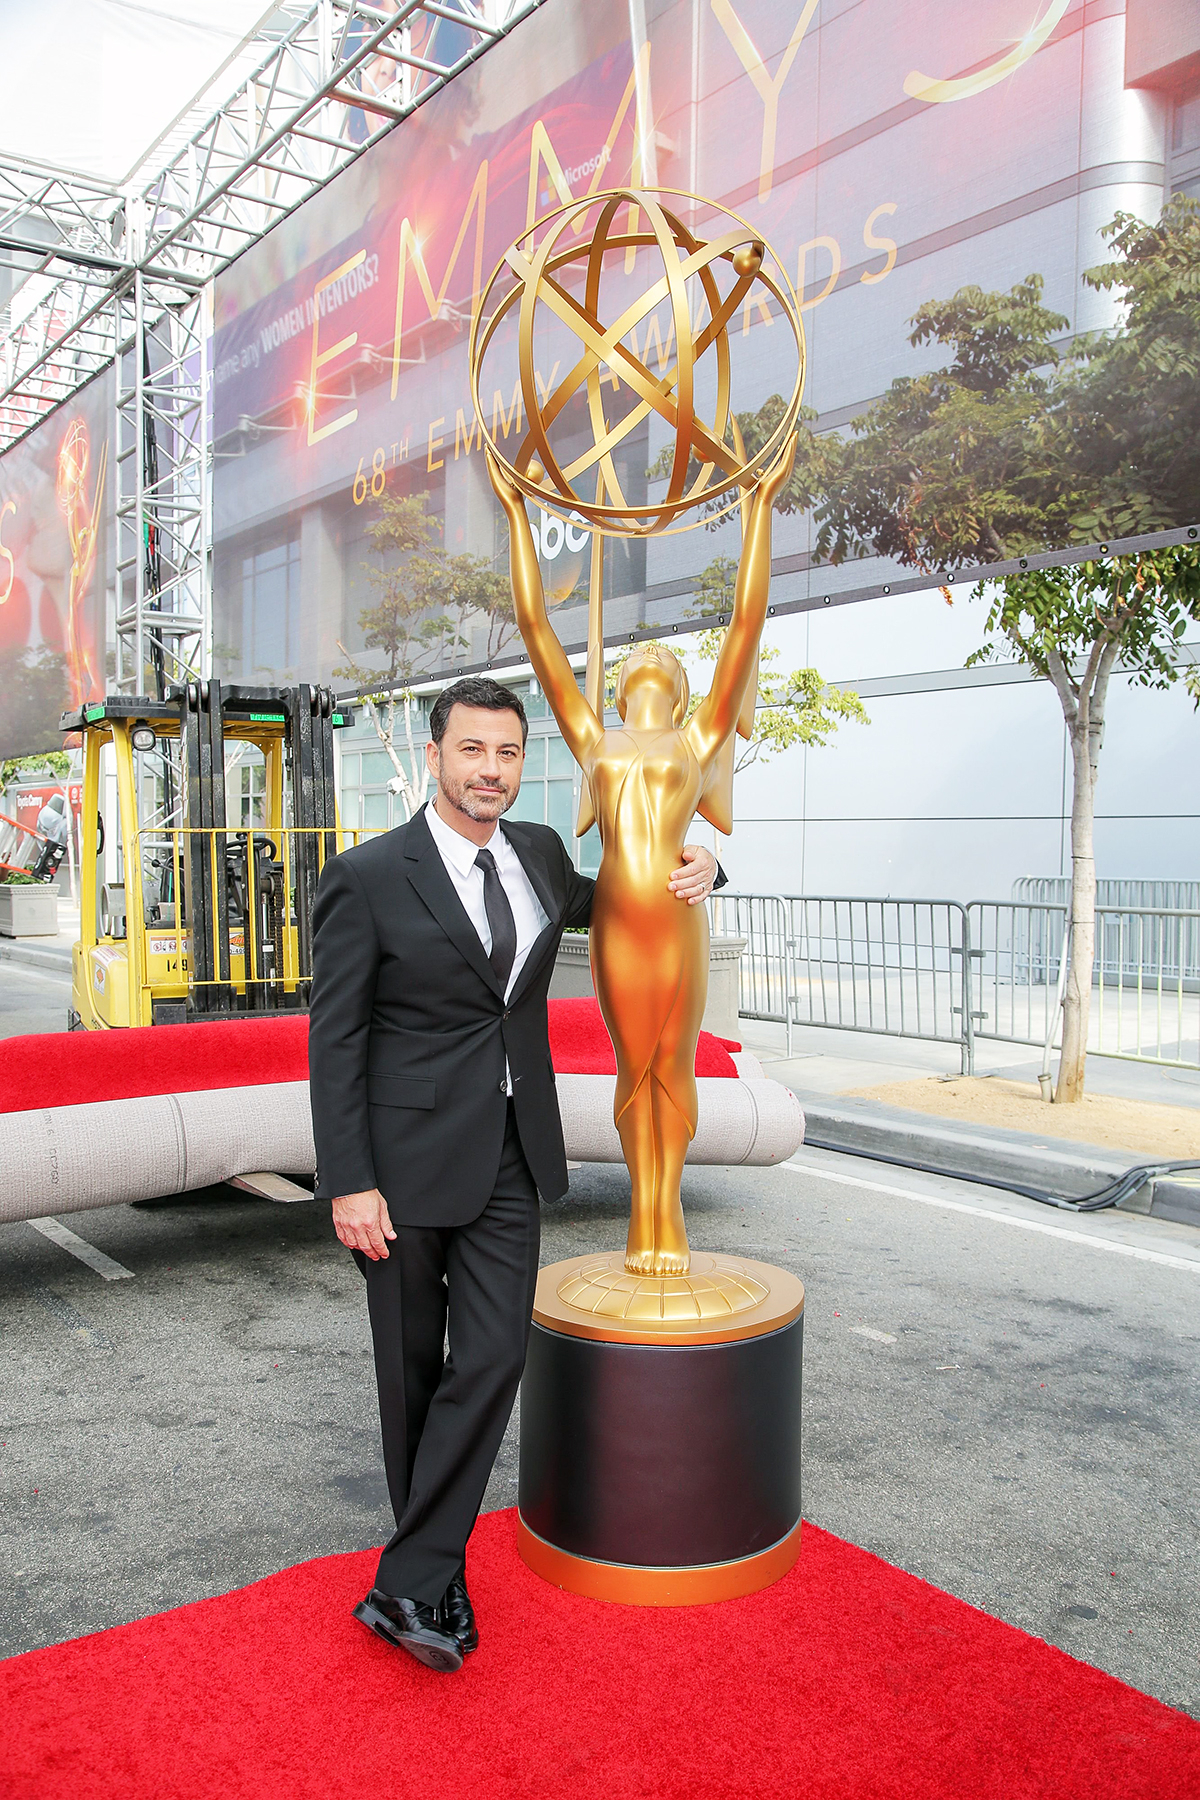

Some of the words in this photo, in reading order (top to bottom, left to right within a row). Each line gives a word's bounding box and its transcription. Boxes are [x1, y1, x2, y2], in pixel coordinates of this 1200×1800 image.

[557, 144, 611, 190] Microsoft
[240, 340, 261, 369] any
[260, 305, 305, 354] WOMEN
[305, 253, 379, 326] INVENTORS?
[427, 360, 560, 473] EMMY
